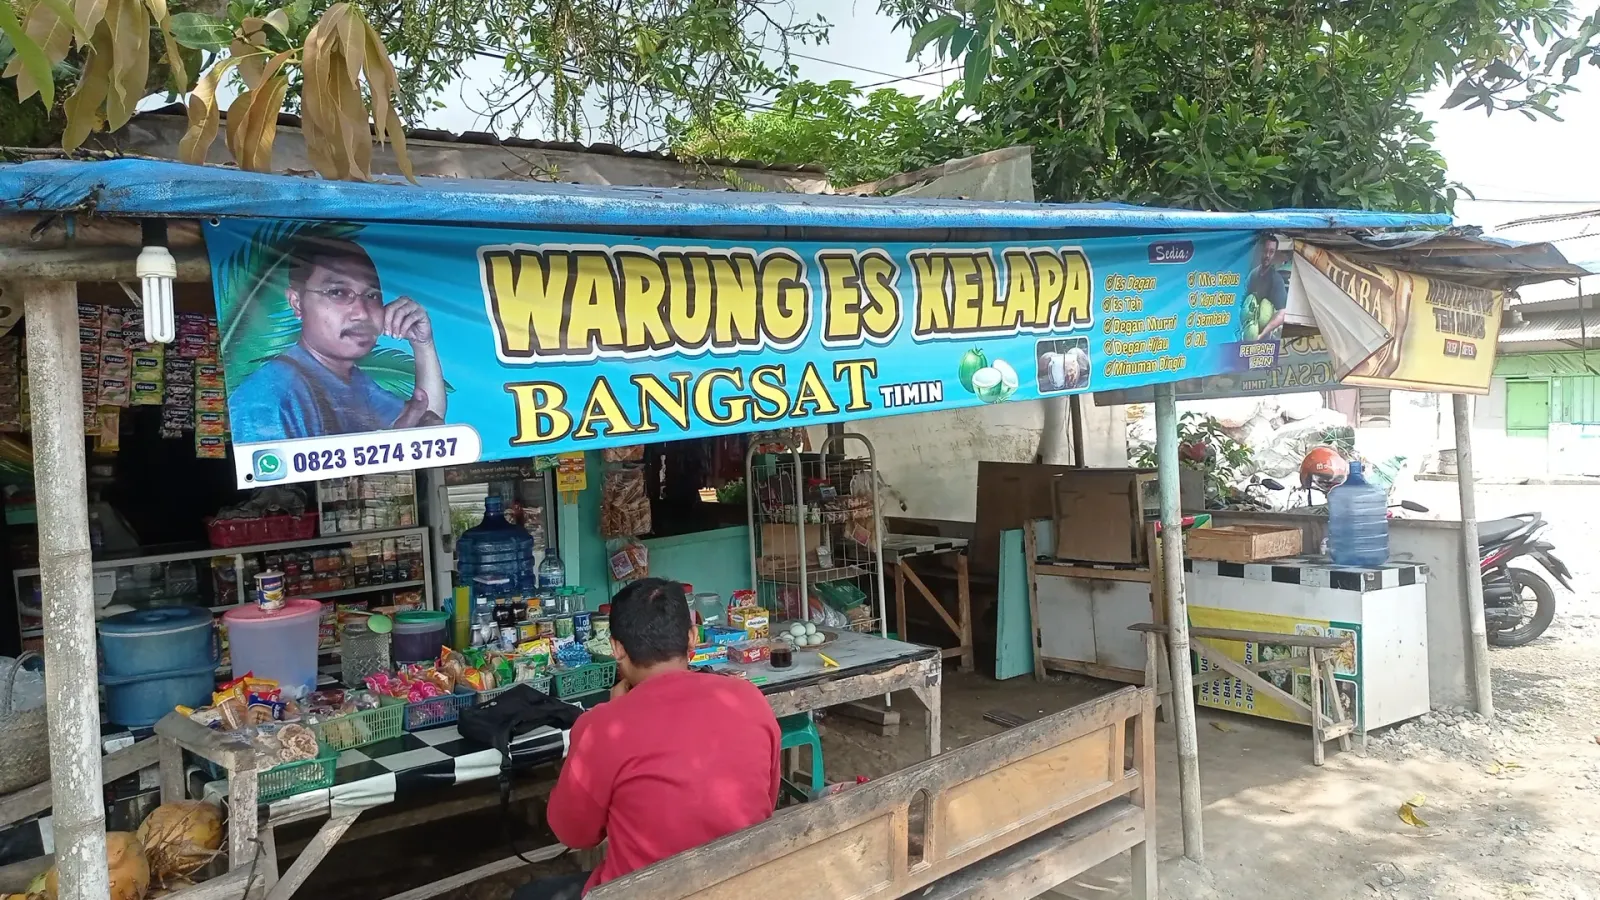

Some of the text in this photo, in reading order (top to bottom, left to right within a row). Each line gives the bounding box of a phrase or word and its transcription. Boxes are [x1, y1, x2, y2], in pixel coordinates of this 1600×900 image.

[1155, 245, 1189, 261] Sedia:
[1113, 275, 1157, 294] Es Degan
[1198, 271, 1241, 288] Mie Rebus
[482, 247, 1094, 361] WARUNG ES KELAPA
[1112, 295, 1143, 312] Es Teh
[1217, 290, 1236, 306] Susu
[1113, 314, 1178, 336] Degan Murni
[1114, 337, 1170, 357] Degan Hijau
[1114, 353, 1187, 377] Minuman Dingin
[505, 357, 944, 447] BANGSAT TIMIN
[293, 437, 458, 473] 0823 5274 3737
